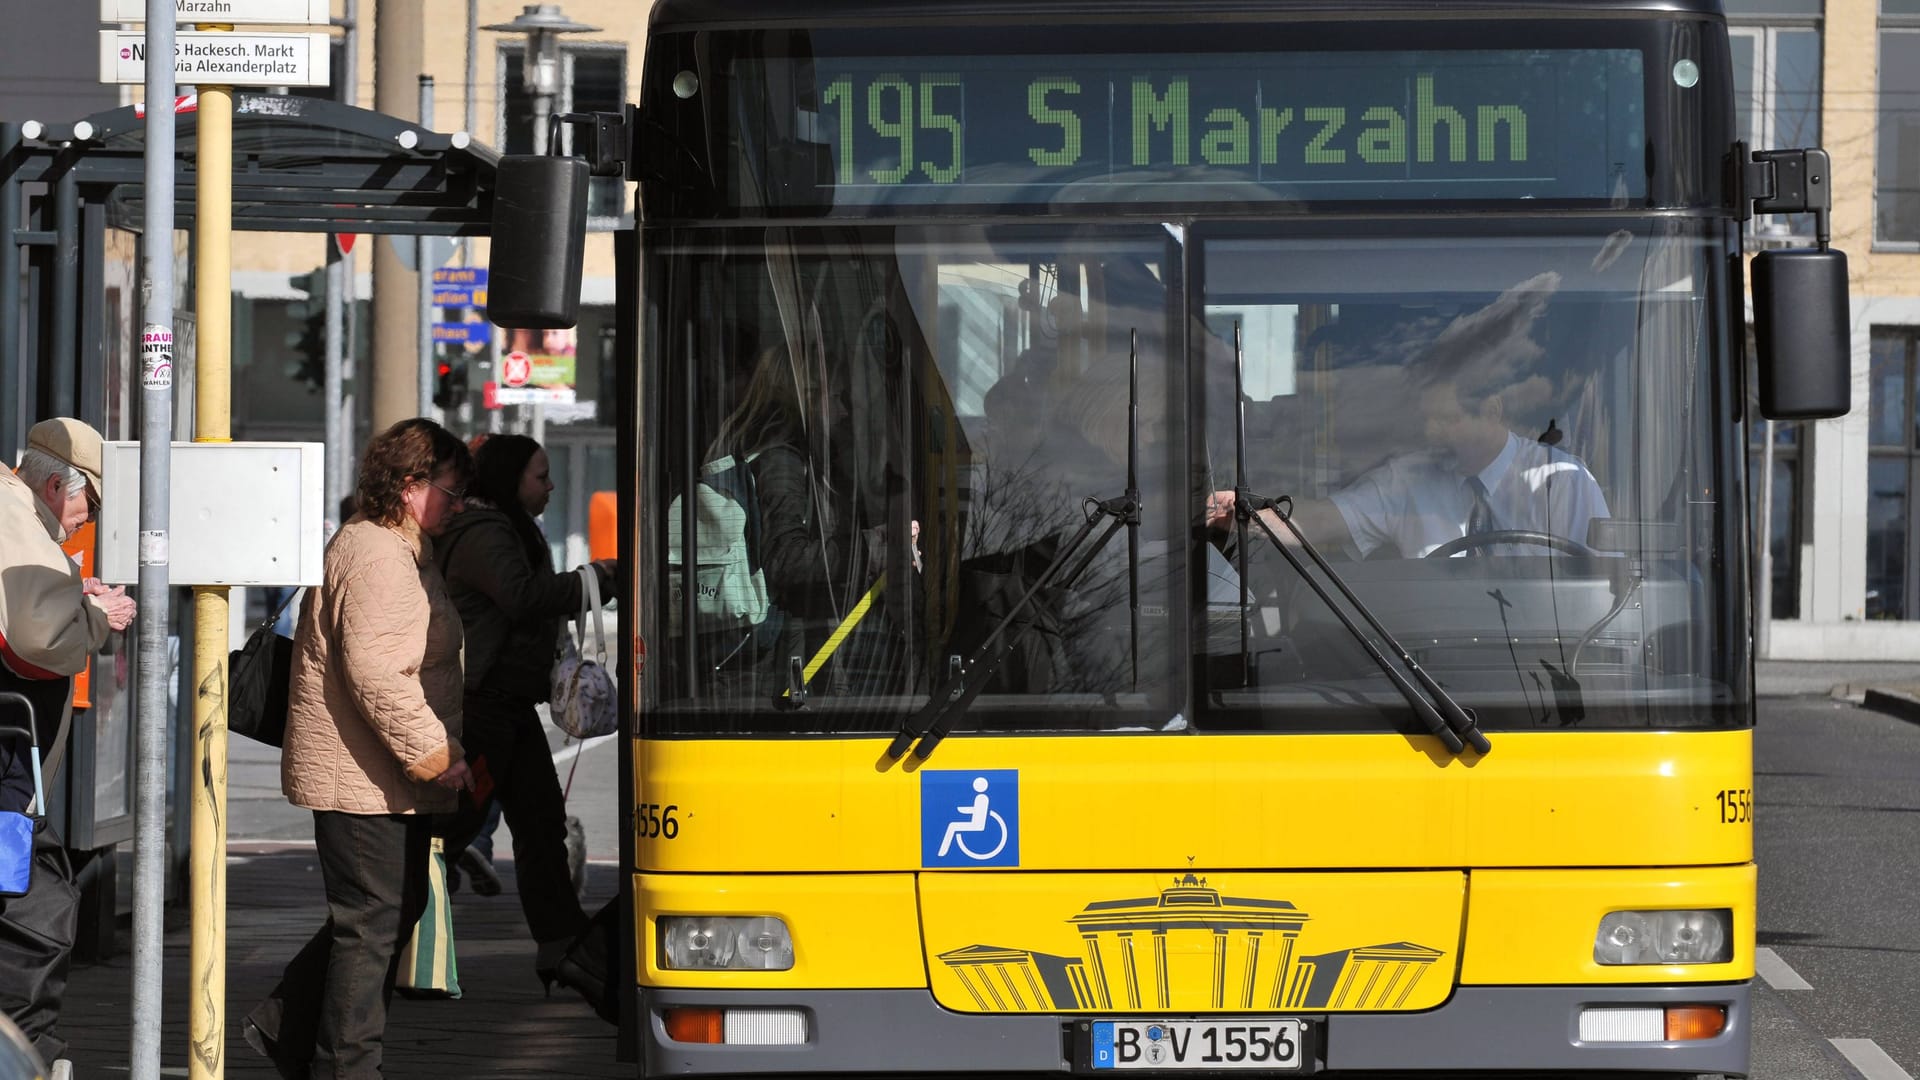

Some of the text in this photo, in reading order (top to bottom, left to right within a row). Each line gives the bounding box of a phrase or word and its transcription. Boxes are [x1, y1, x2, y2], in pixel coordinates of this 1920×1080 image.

[176, 0, 231, 12] Marzahn
[185, 44, 250, 57] Hackesch.
[255, 45, 294, 57] Markt
[175, 60, 297, 76] via Alexanderplatz
[823, 73, 1527, 184] 195 S Marzahn
[1716, 788, 1752, 824] 1556
[1118, 1027, 1295, 1062] B V 1556
[1100, 1051, 1108, 1061] D
